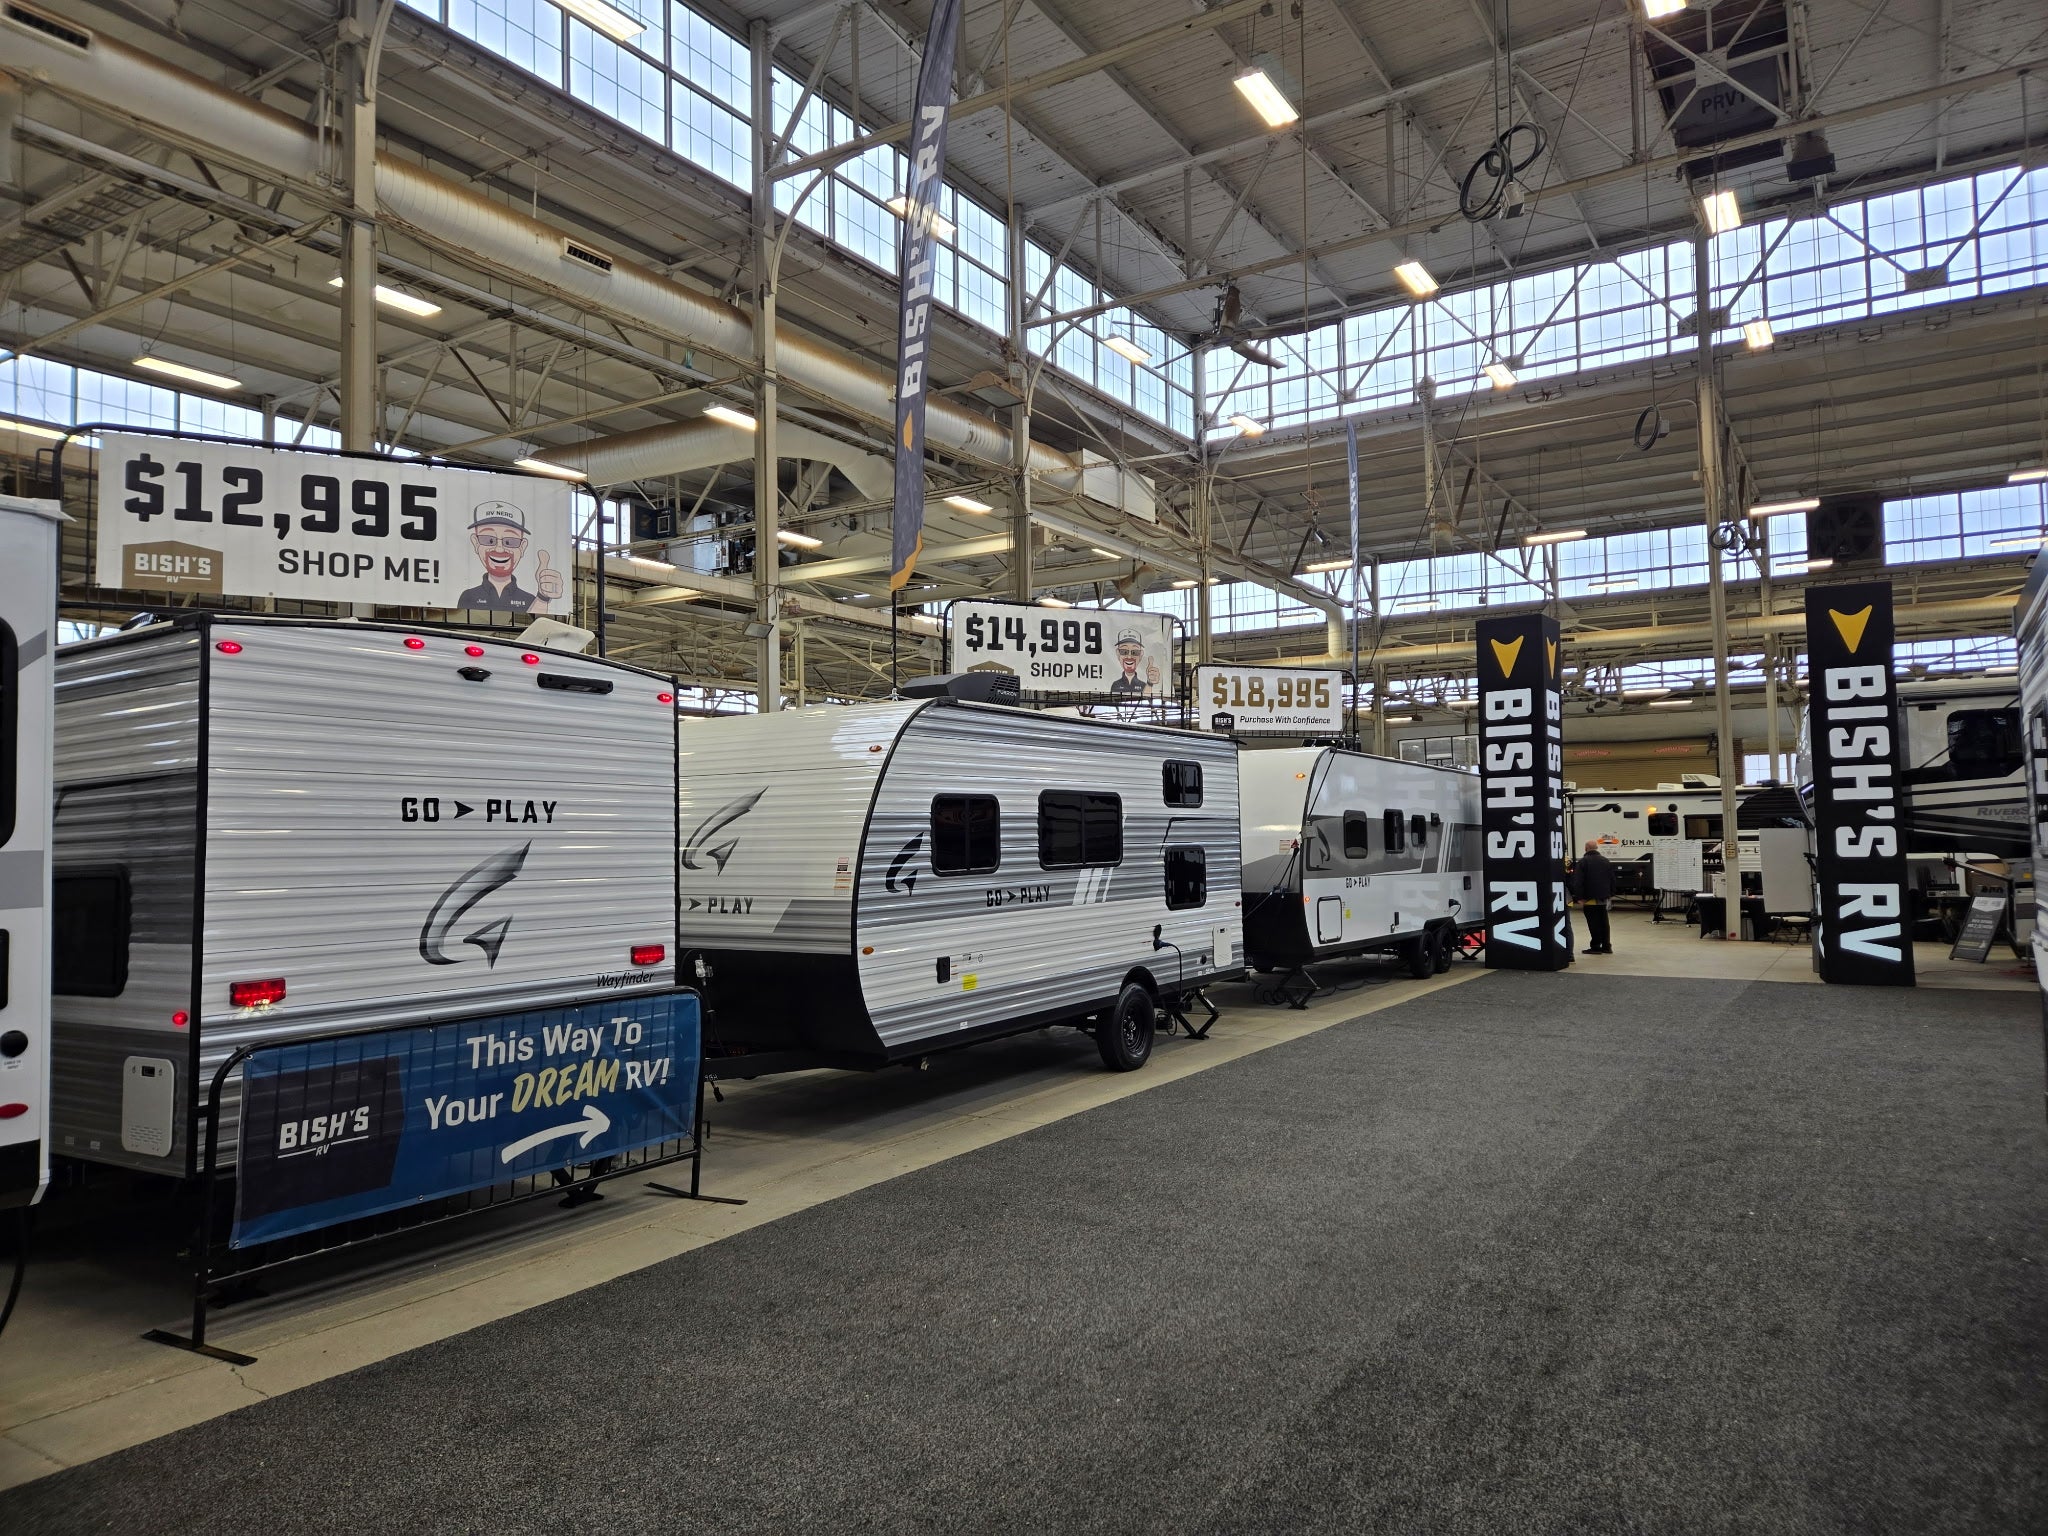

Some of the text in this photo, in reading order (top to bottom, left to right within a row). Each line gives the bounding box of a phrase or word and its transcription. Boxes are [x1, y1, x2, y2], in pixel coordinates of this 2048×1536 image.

[900, 105, 945, 398] BISH'S RV
[124, 452, 437, 541] $12,995
[135, 553, 212, 575] BISH'S
[166, 575, 180, 583] RV
[278, 548, 440, 584] SHOP ME!
[966, 613, 1103, 658] $14,999
[1030, 662, 1104, 680] SHOP ME!
[1212, 672, 1330, 713] $18,995
[1240, 715, 1331, 726] Purchase With Confidence
[401, 797, 558, 824] GO PLAY
[1484, 688, 1542, 951] BISH'S RV
[1545, 688, 1568, 949] BISH'S RV
[1825, 664, 1902, 962] BISH'S RV
[707, 896, 754, 915] PLAY
[986, 885, 1050, 907] GO PLAY
[596, 971, 655, 990] Wayfinder
[466, 1016, 643, 1070] This Way To
[424, 1057, 670, 1131] Your DREAM RV!
[279, 1105, 370, 1150] BISH'S
[315, 1143, 330, 1157] RV
